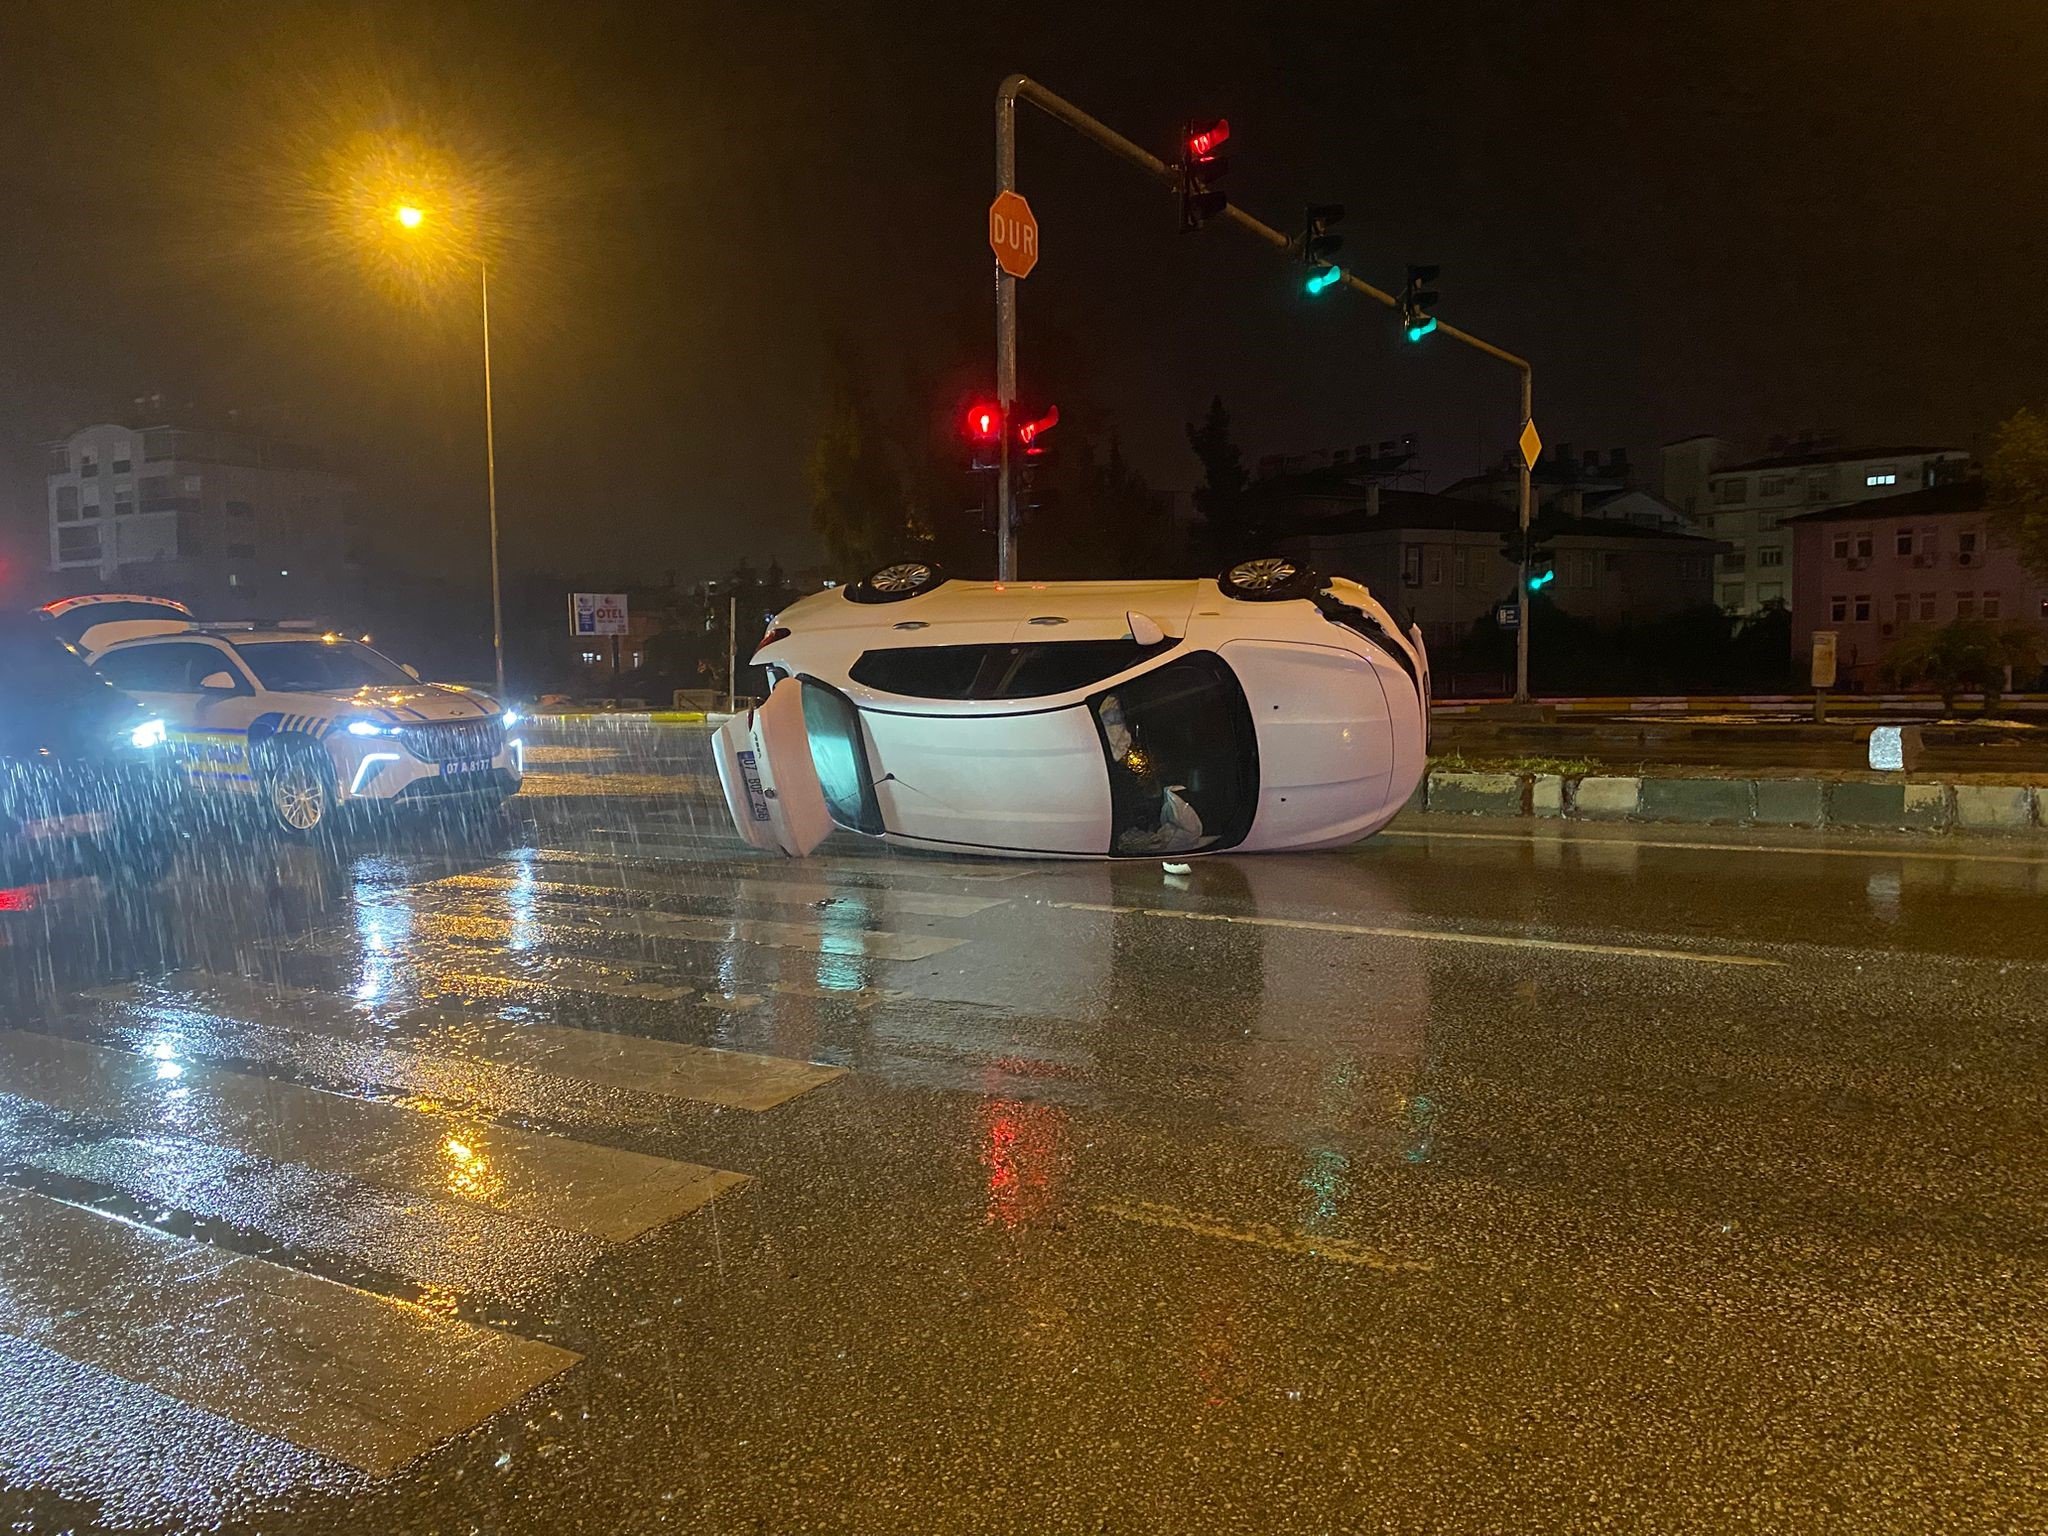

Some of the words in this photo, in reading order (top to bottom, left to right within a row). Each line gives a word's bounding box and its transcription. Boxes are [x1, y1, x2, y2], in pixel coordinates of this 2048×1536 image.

[994, 212, 1033, 257] DUR
[596, 608, 624, 619] OTEL
[446, 762, 459, 774] 07
[461, 761, 468, 773] A
[743, 759, 757, 771] 07
